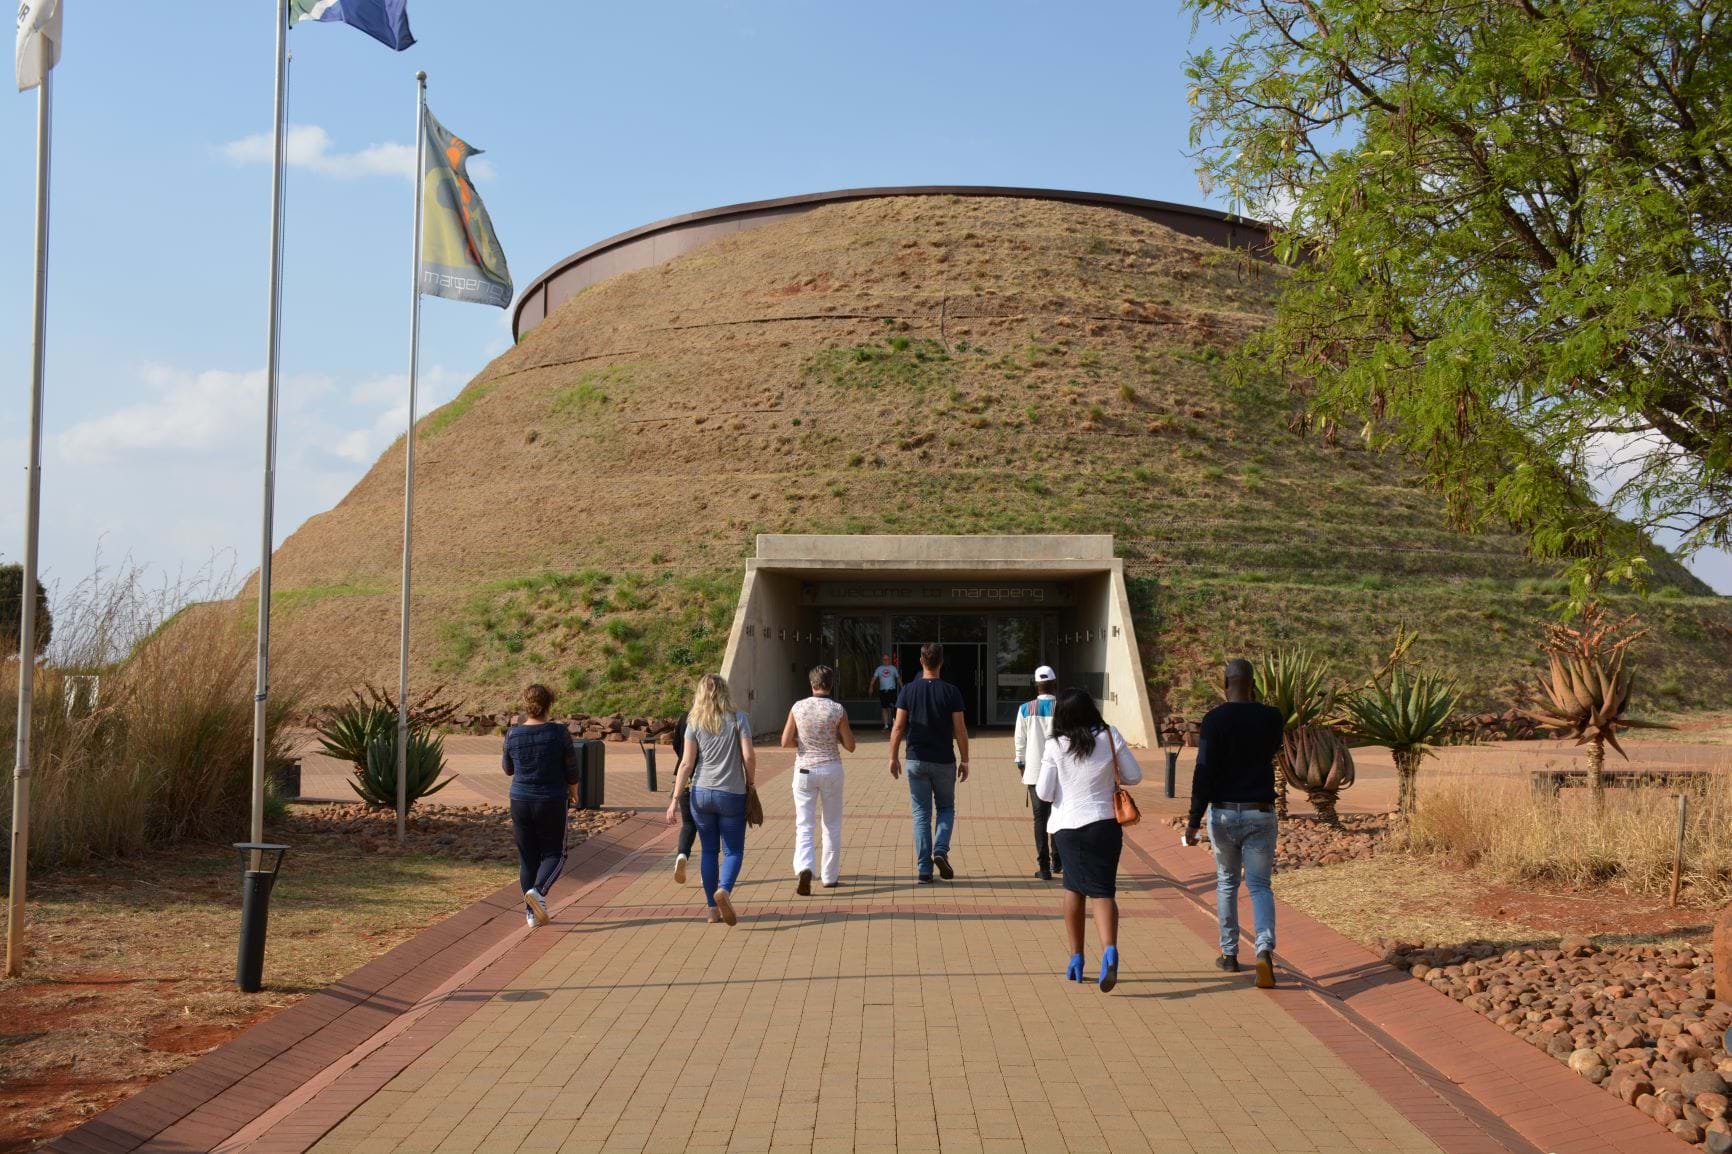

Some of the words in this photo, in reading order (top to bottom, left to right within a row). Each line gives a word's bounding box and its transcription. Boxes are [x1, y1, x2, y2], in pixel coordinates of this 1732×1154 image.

[829, 587, 913, 598] welcome
[921, 587, 943, 598] to
[951, 587, 1044, 601] maropeng
